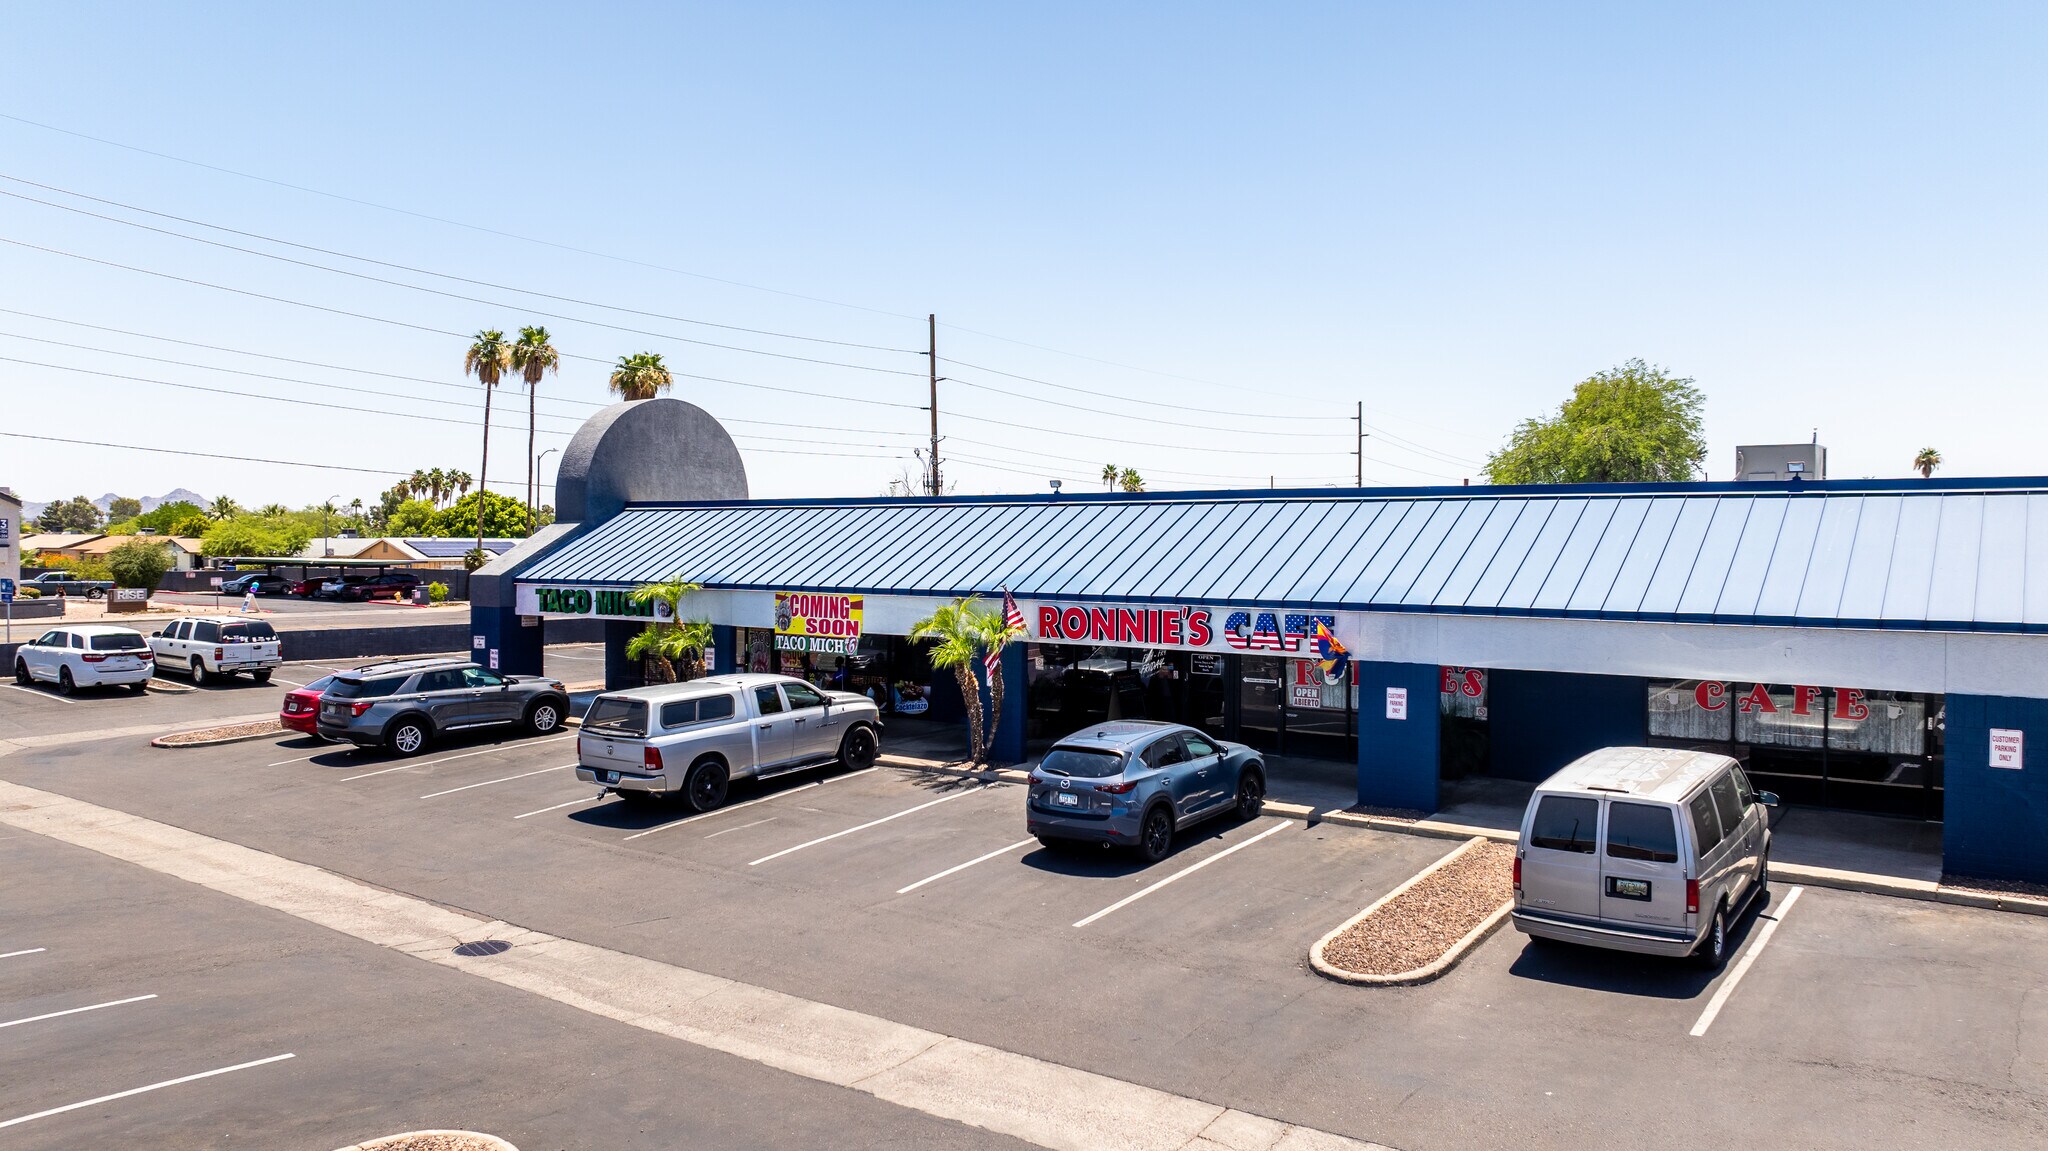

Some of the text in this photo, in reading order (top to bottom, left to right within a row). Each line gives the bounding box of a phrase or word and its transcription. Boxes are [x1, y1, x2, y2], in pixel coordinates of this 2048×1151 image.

[117, 590, 145, 600] RISE
[535, 588, 655, 617] TACO MICH
[789, 594, 850, 619] COMING
[805, 618, 859, 636] SOON
[1038, 605, 1335, 653] RONNIE'S CAFE
[775, 635, 806, 651] TACO
[809, 637, 844, 653] MICH
[1296, 688, 1317, 698] OPEN
[1294, 698, 1319, 707] ABIERTO
[1694, 680, 1870, 721] CAFE
[1992, 735, 2020, 744] CUSTOMER
[1994, 744, 2017, 753] PARKING
[1999, 754, 2012, 762] ONLY
